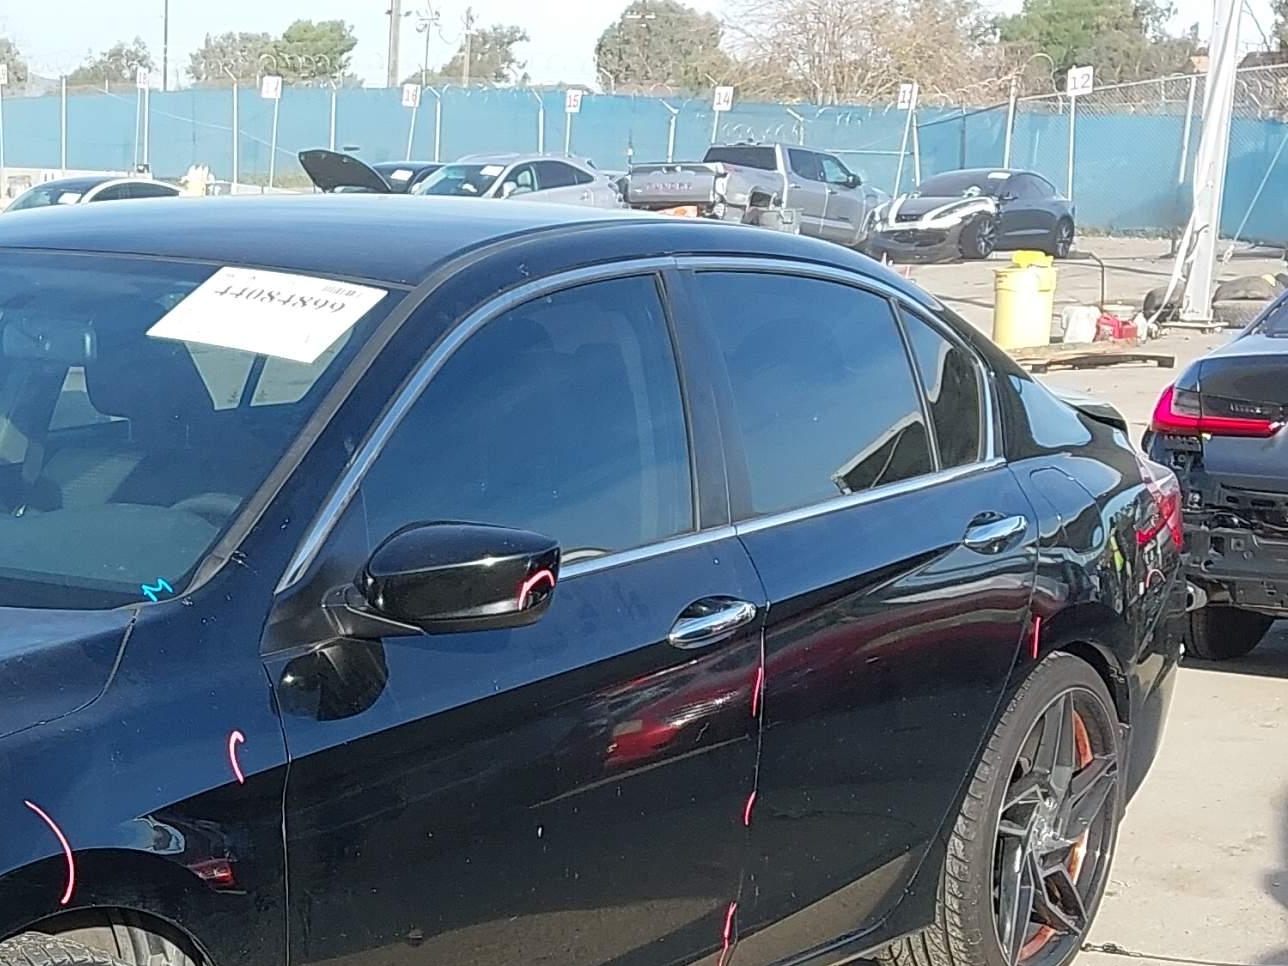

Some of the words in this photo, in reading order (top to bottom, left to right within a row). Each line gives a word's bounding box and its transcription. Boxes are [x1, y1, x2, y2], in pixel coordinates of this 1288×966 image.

[1070, 74, 1090, 90] 12
[568, 94, 579, 108] 15
[716, 91, 730, 106] 14
[214, 285, 346, 313] 44084899
